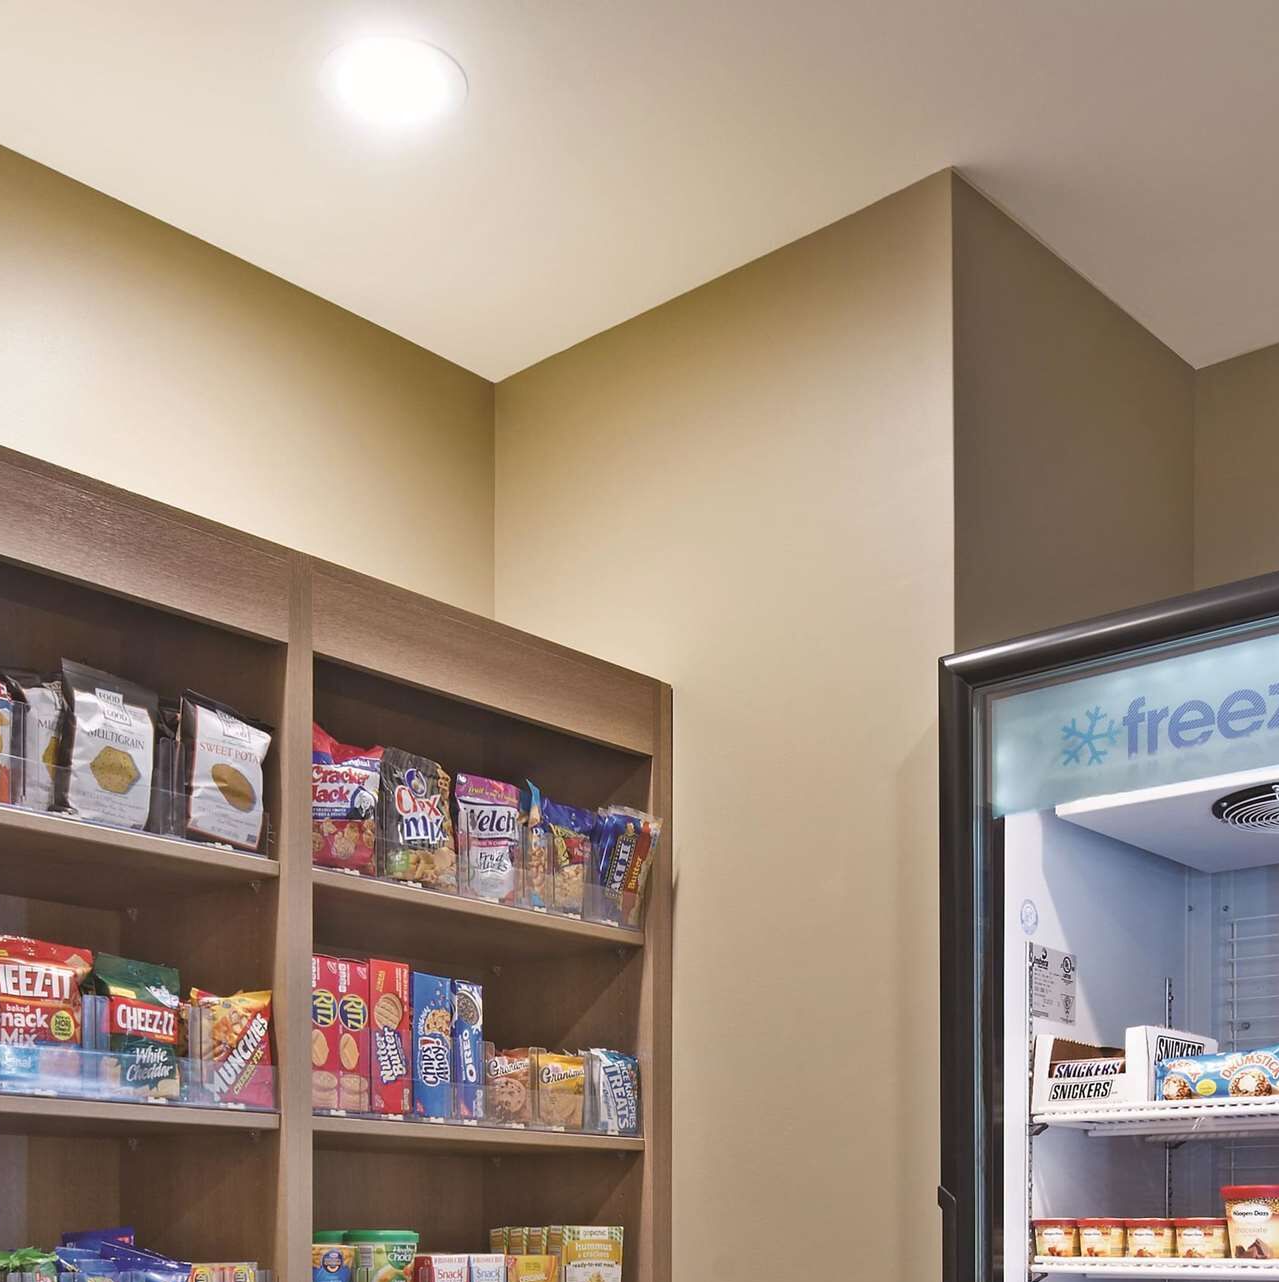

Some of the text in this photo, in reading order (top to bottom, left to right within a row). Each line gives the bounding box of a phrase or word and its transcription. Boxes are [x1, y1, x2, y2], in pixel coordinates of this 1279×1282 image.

[88, 728, 144, 750] MULTIGRAIN
[628, 857, 642, 889] Butter
[6, 1004, 30, 1013] baked
[0, 1026, 36, 1048] Mix
[135, 1047, 168, 1064] White
[463, 1030, 476, 1082] OREO
[126, 1060, 173, 1083] Cheddar
[605, 1065, 628, 1129] TREATS
[1052, 1083, 1110, 1099] SNICKERS
[438, 1270, 463, 1280] Snack
[477, 1269, 500, 1279] Snack
